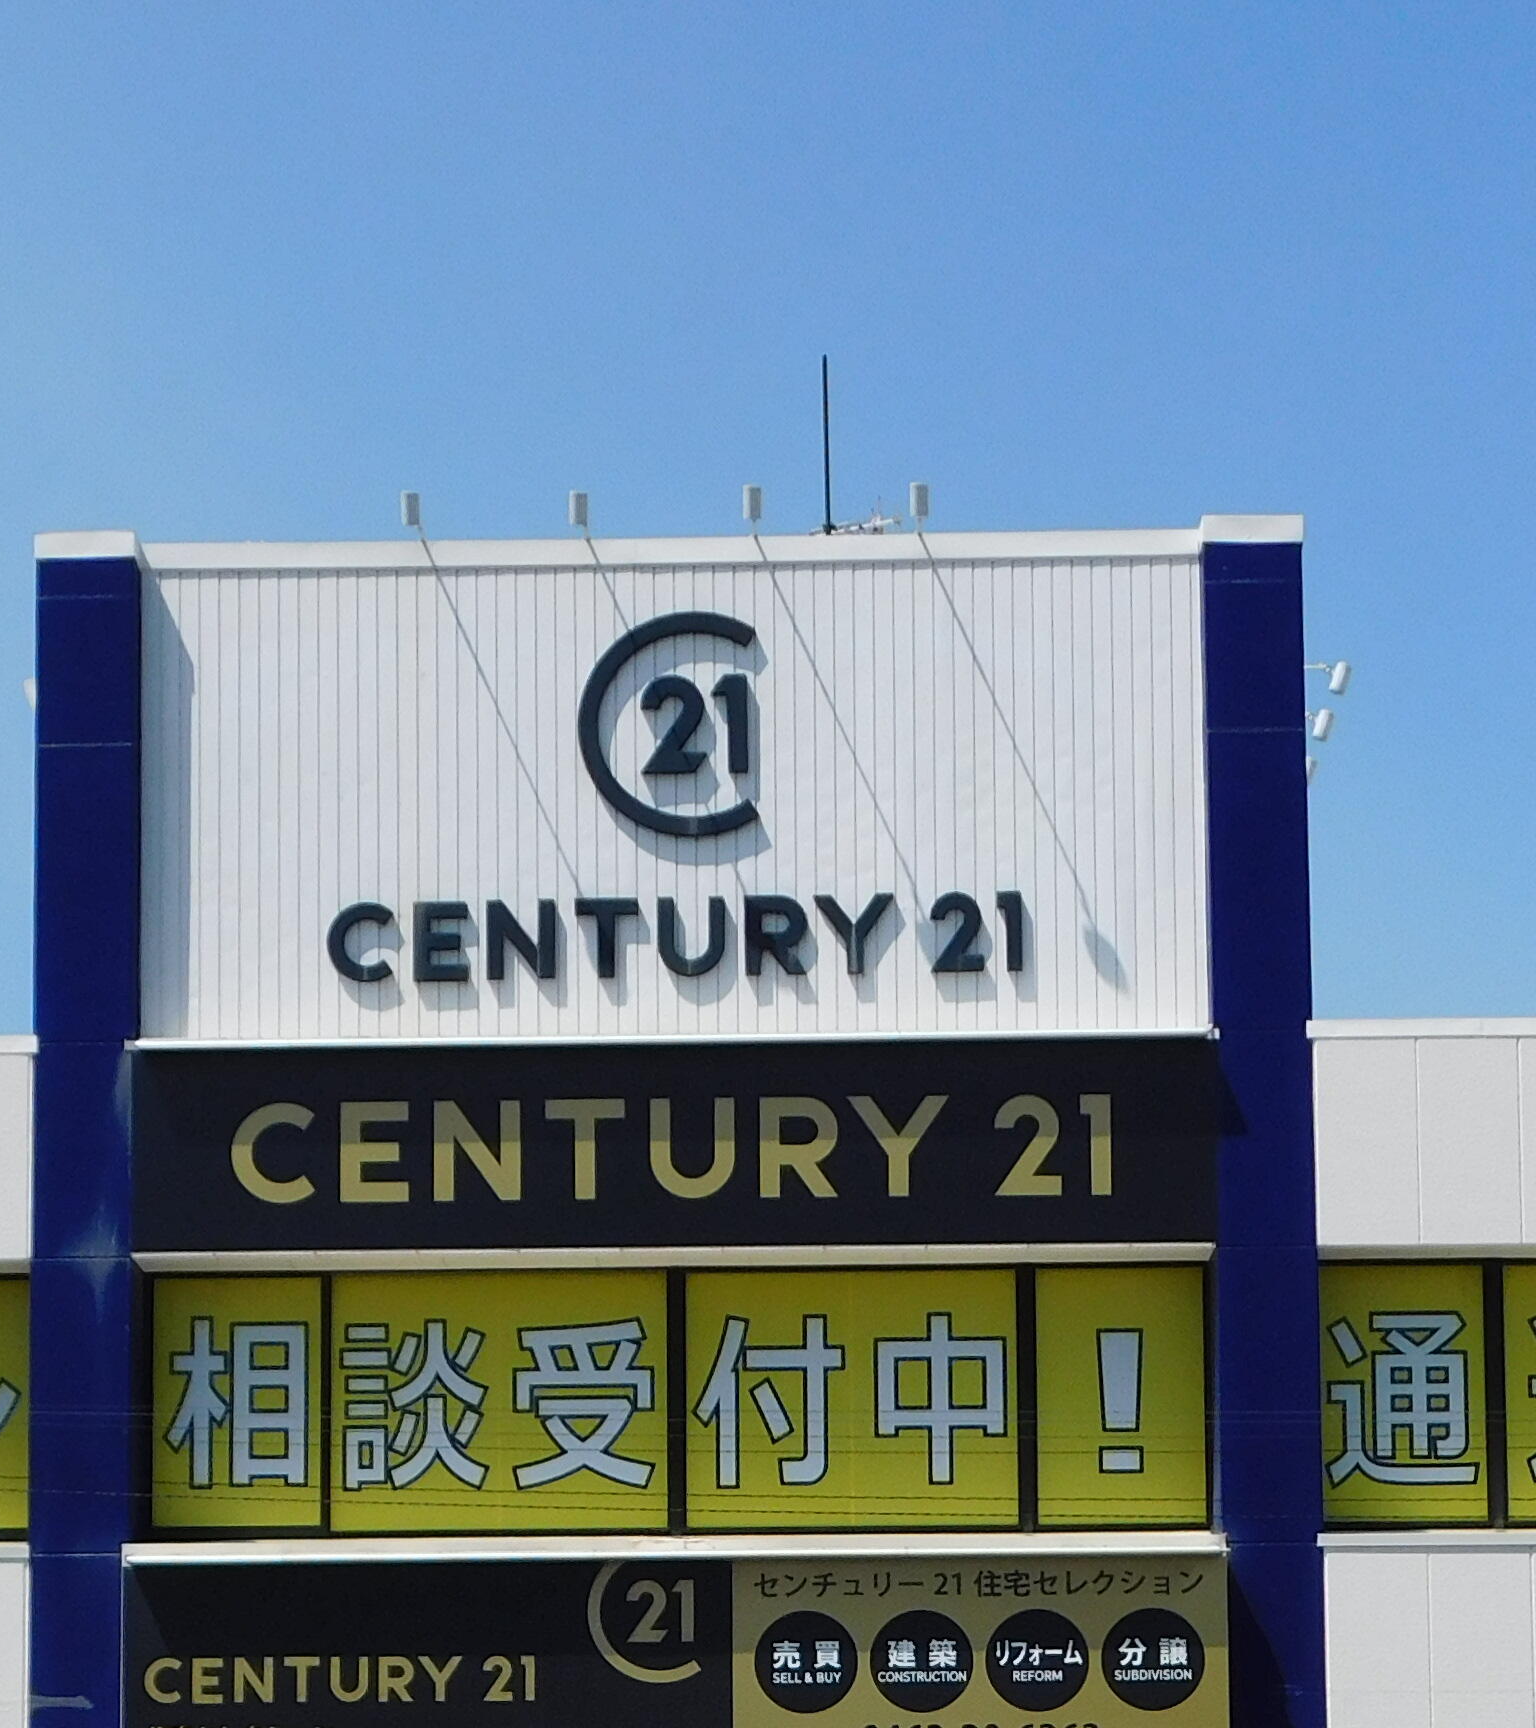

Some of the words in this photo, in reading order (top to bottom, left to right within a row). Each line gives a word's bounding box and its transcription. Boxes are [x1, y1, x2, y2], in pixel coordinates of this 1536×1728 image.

[325, 892, 895, 984] CENTURY
[928, 890, 1025, 974] 21
[230, 1095, 950, 1205] CENTURY
[992, 1093, 1113, 1199] 21
[754, 1570, 924, 1599] センチュリー
[933, 1571, 963, 1597] 21
[973, 1568, 1205, 1598] 住宅セレクション
[994, 1639, 1084, 1667] リフォーム
[143, 1655, 463, 1706] CENTURY
[482, 1654, 537, 1703] 21
[772, 1670, 802, 1684] SELL
[804, 1670, 814, 1684] &
[816, 1670, 843, 1684] BUY
[877, 1669, 968, 1684] CONSTRUCTION
[1012, 1669, 1064, 1683] REFORM
[1113, 1668, 1194, 1682] SUBDIVISION
